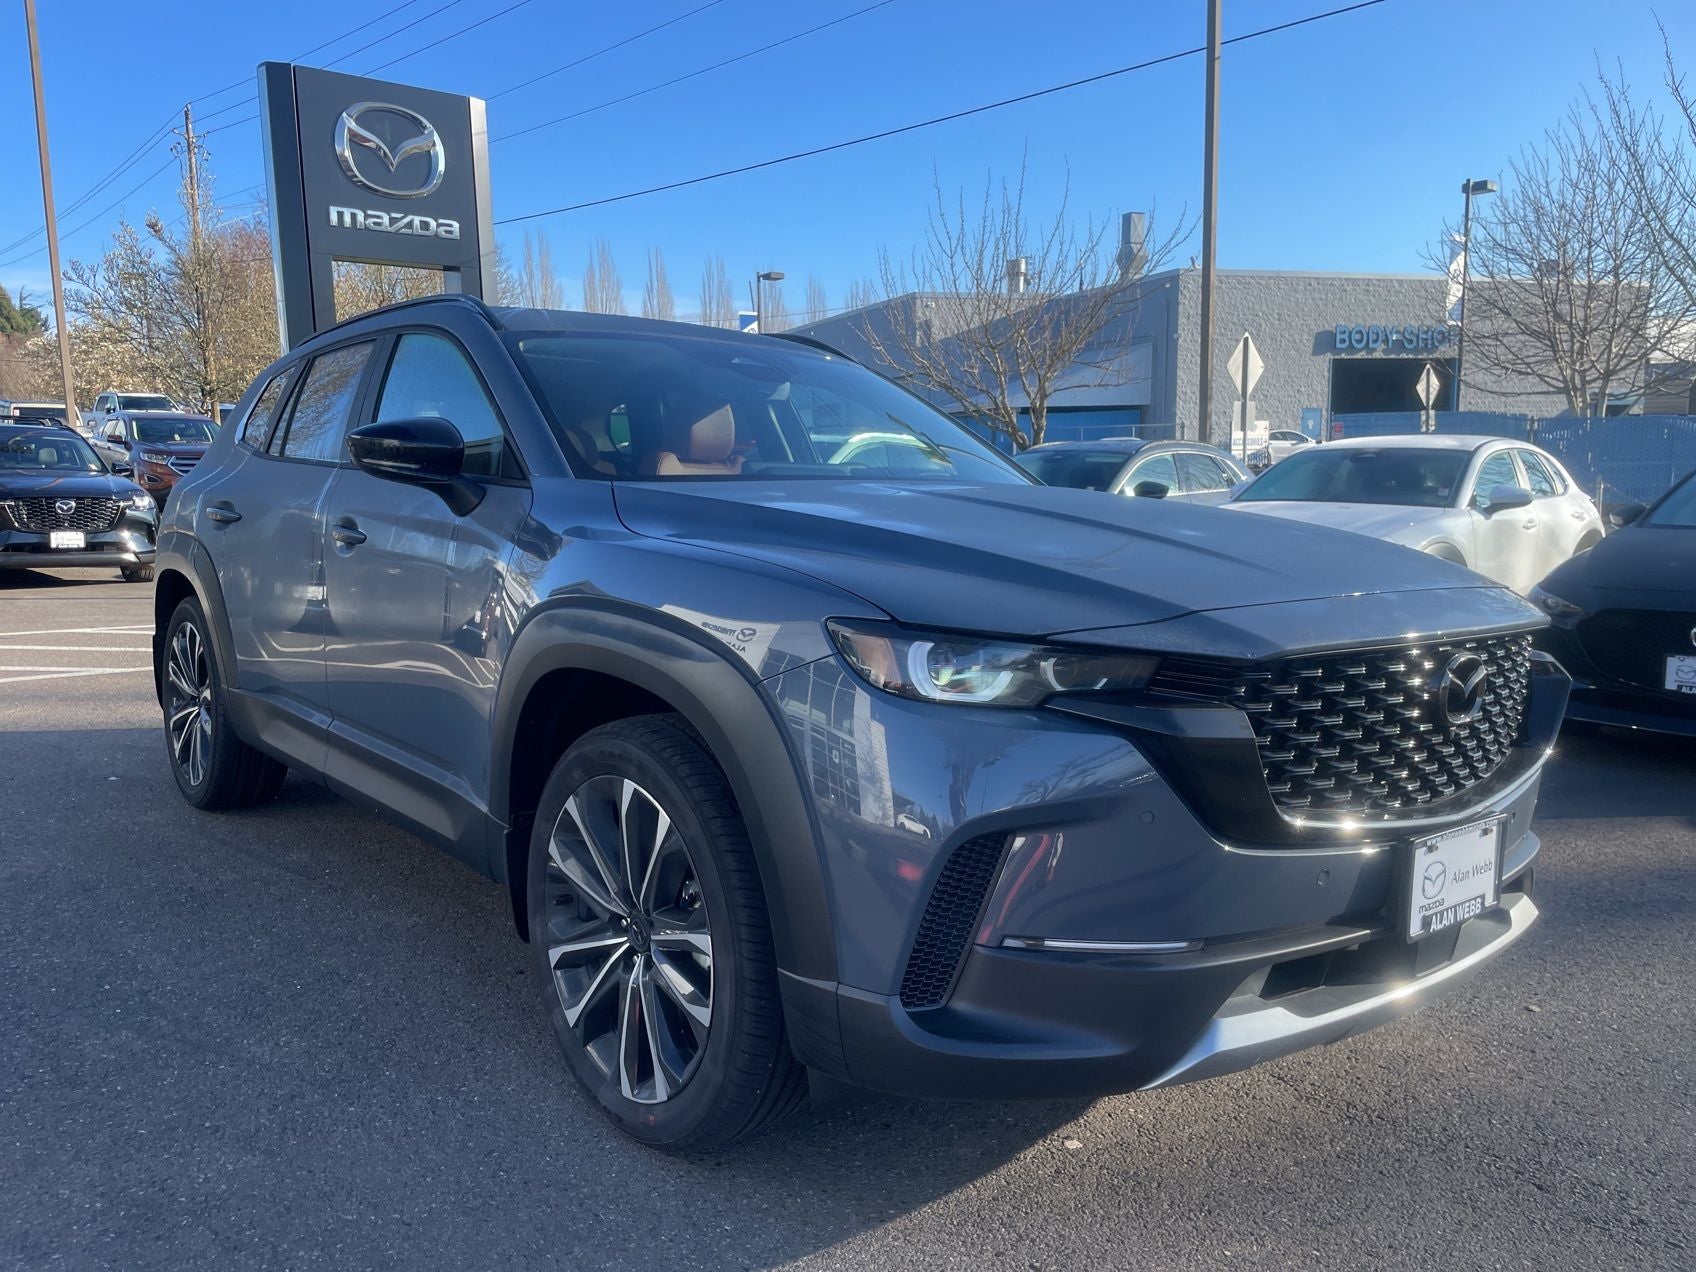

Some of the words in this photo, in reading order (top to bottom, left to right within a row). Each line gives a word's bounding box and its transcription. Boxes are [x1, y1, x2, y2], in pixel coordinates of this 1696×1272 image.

[328, 205, 461, 240] mazda
[1334, 324, 1396, 349] BODY
[1451, 869, 1470, 886] Alan
[1472, 859, 1493, 877] Webb
[1430, 908, 1454, 932] ALAN
[1456, 898, 1481, 921] WEBB
